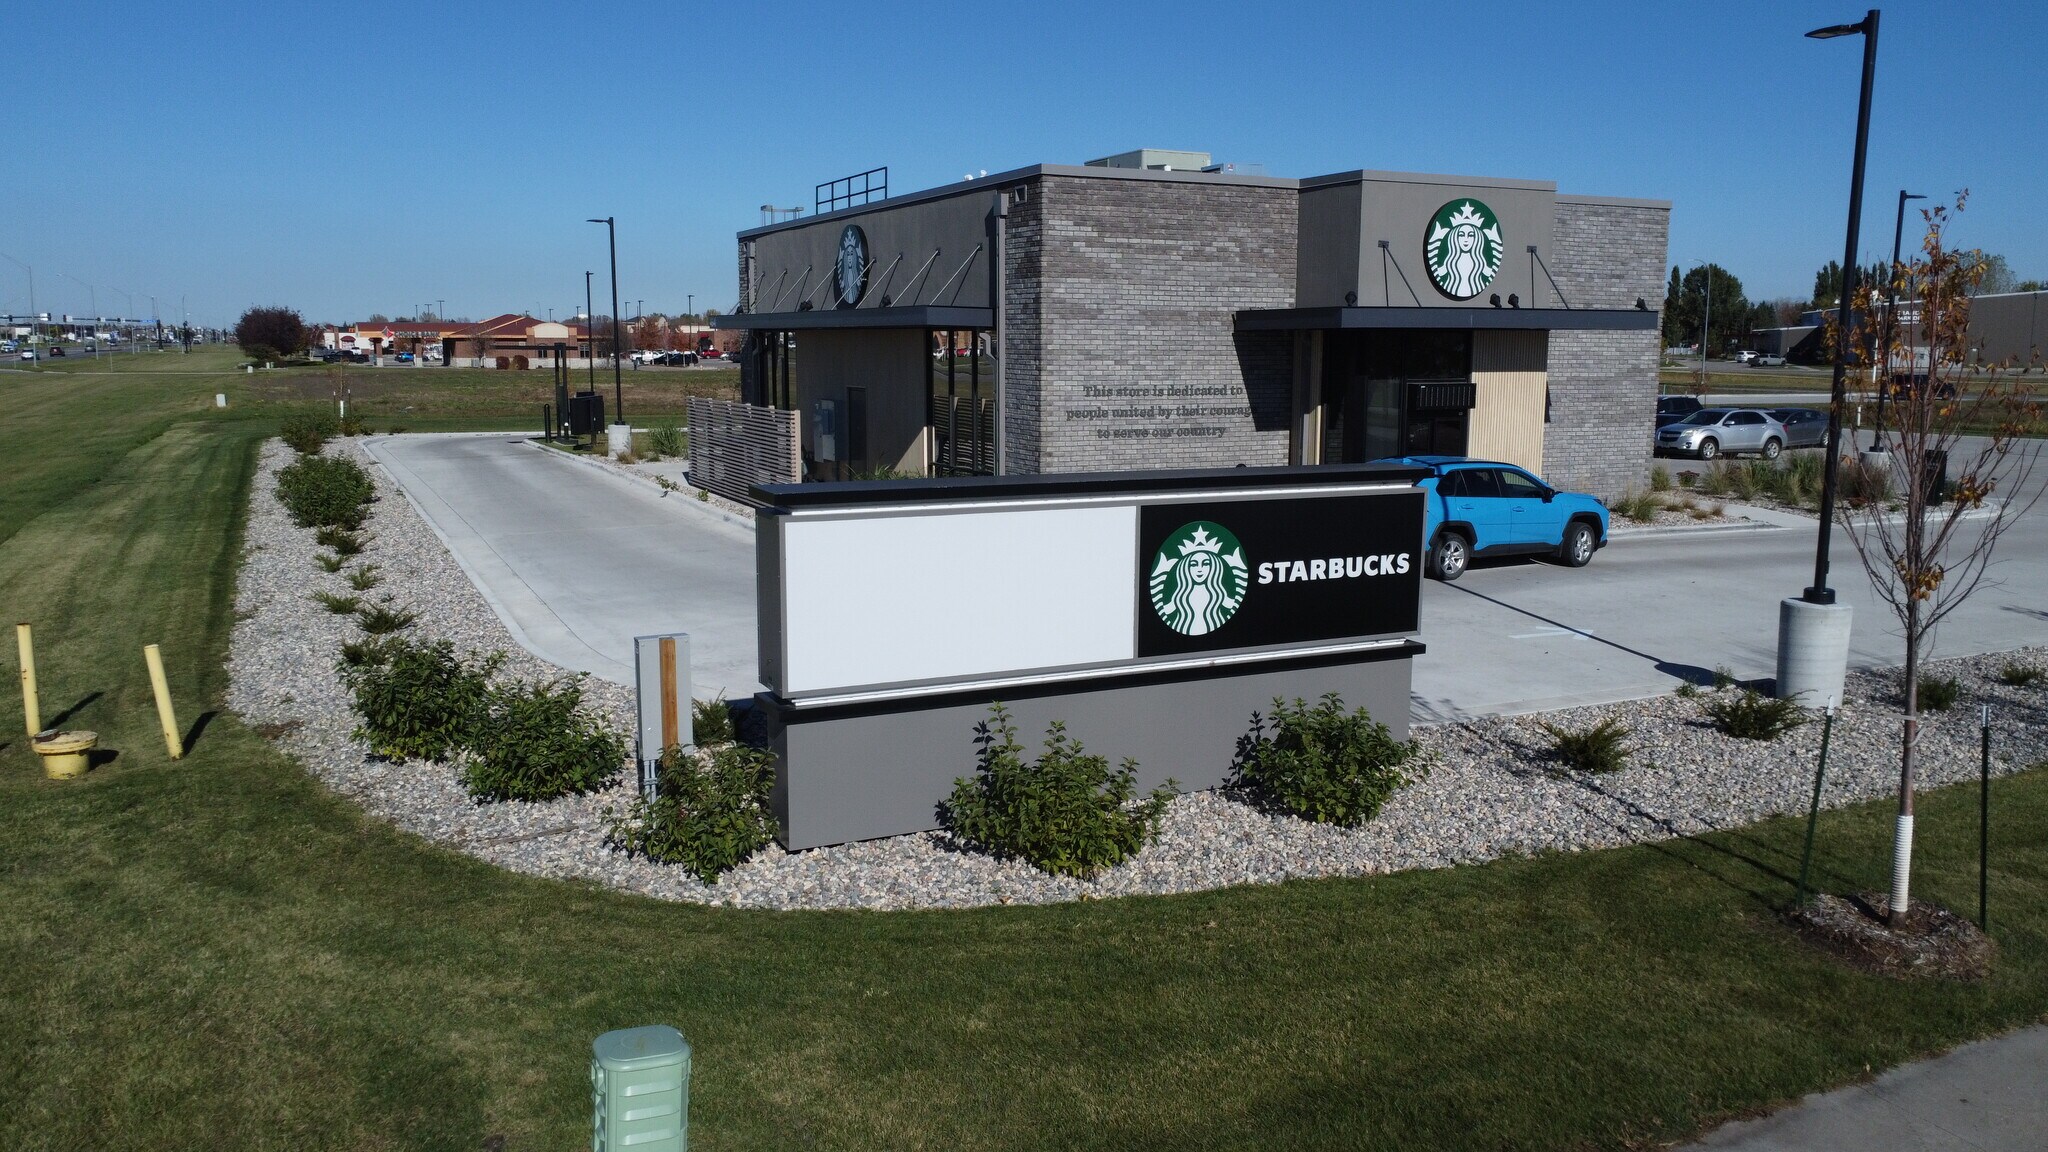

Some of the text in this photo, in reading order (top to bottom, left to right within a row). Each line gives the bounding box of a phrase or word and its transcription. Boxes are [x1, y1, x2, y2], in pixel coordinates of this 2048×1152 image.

[1083, 384, 1243, 397] This store is dedicated to
[1066, 405, 1253, 421] people united by their courag
[1097, 426, 1226, 439] to serve our country
[1258, 552, 1410, 585] STARBUCKS
